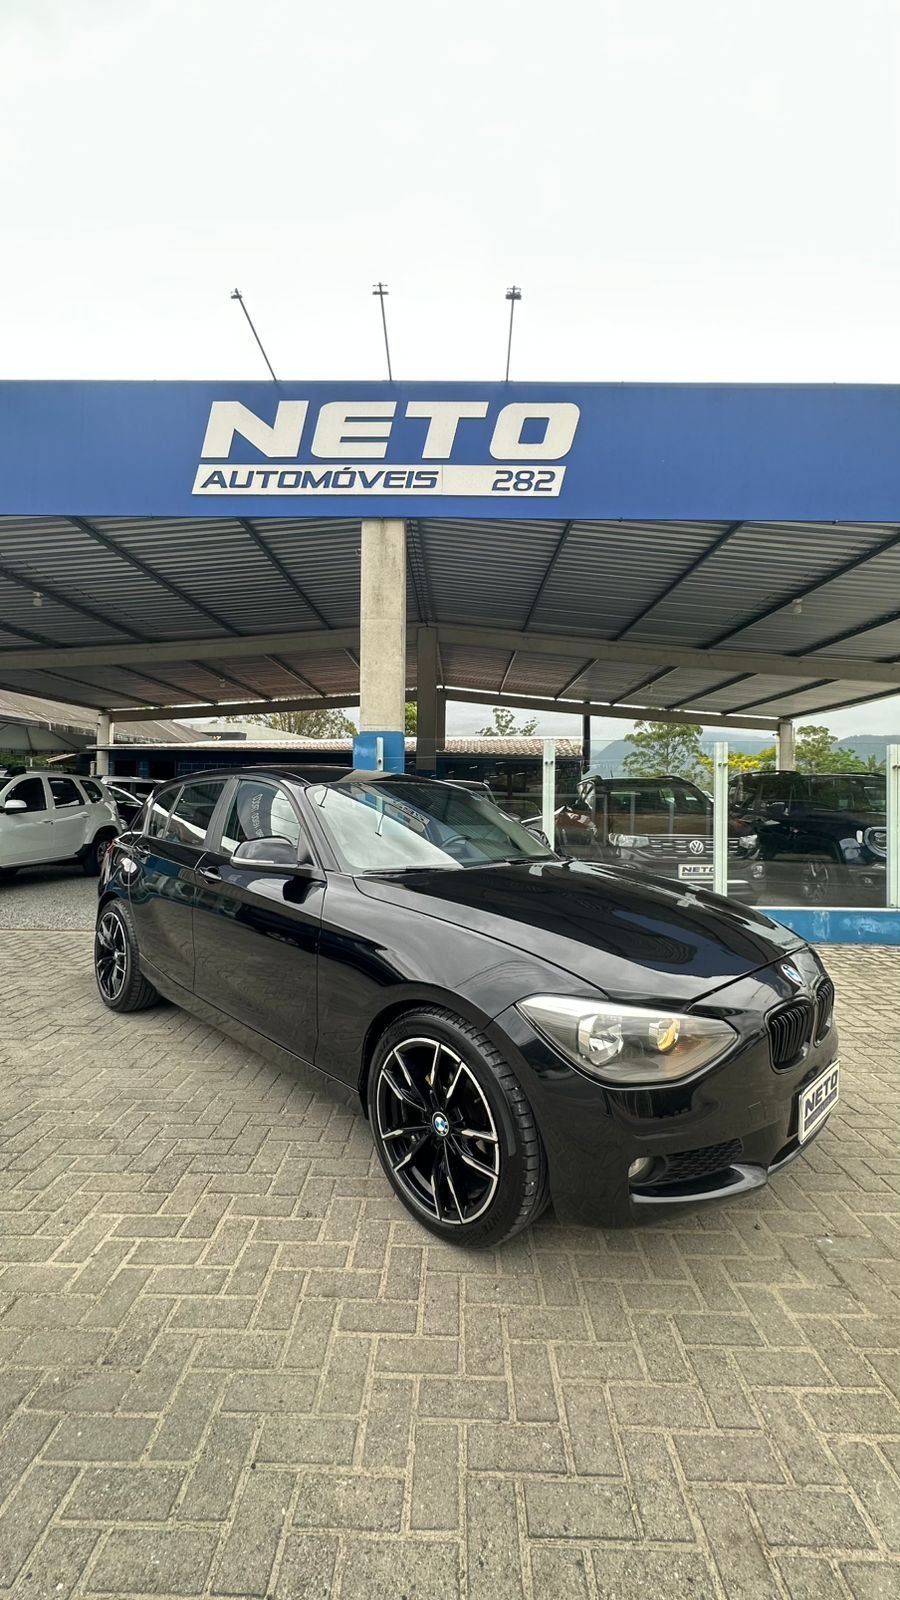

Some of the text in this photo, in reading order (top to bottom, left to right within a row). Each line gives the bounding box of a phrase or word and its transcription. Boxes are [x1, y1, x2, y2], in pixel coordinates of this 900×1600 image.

[200, 400, 581, 460] NETO
[201, 467, 556, 492] AUTOMÓVEIS 282
[804, 1069, 838, 1119] NETO
